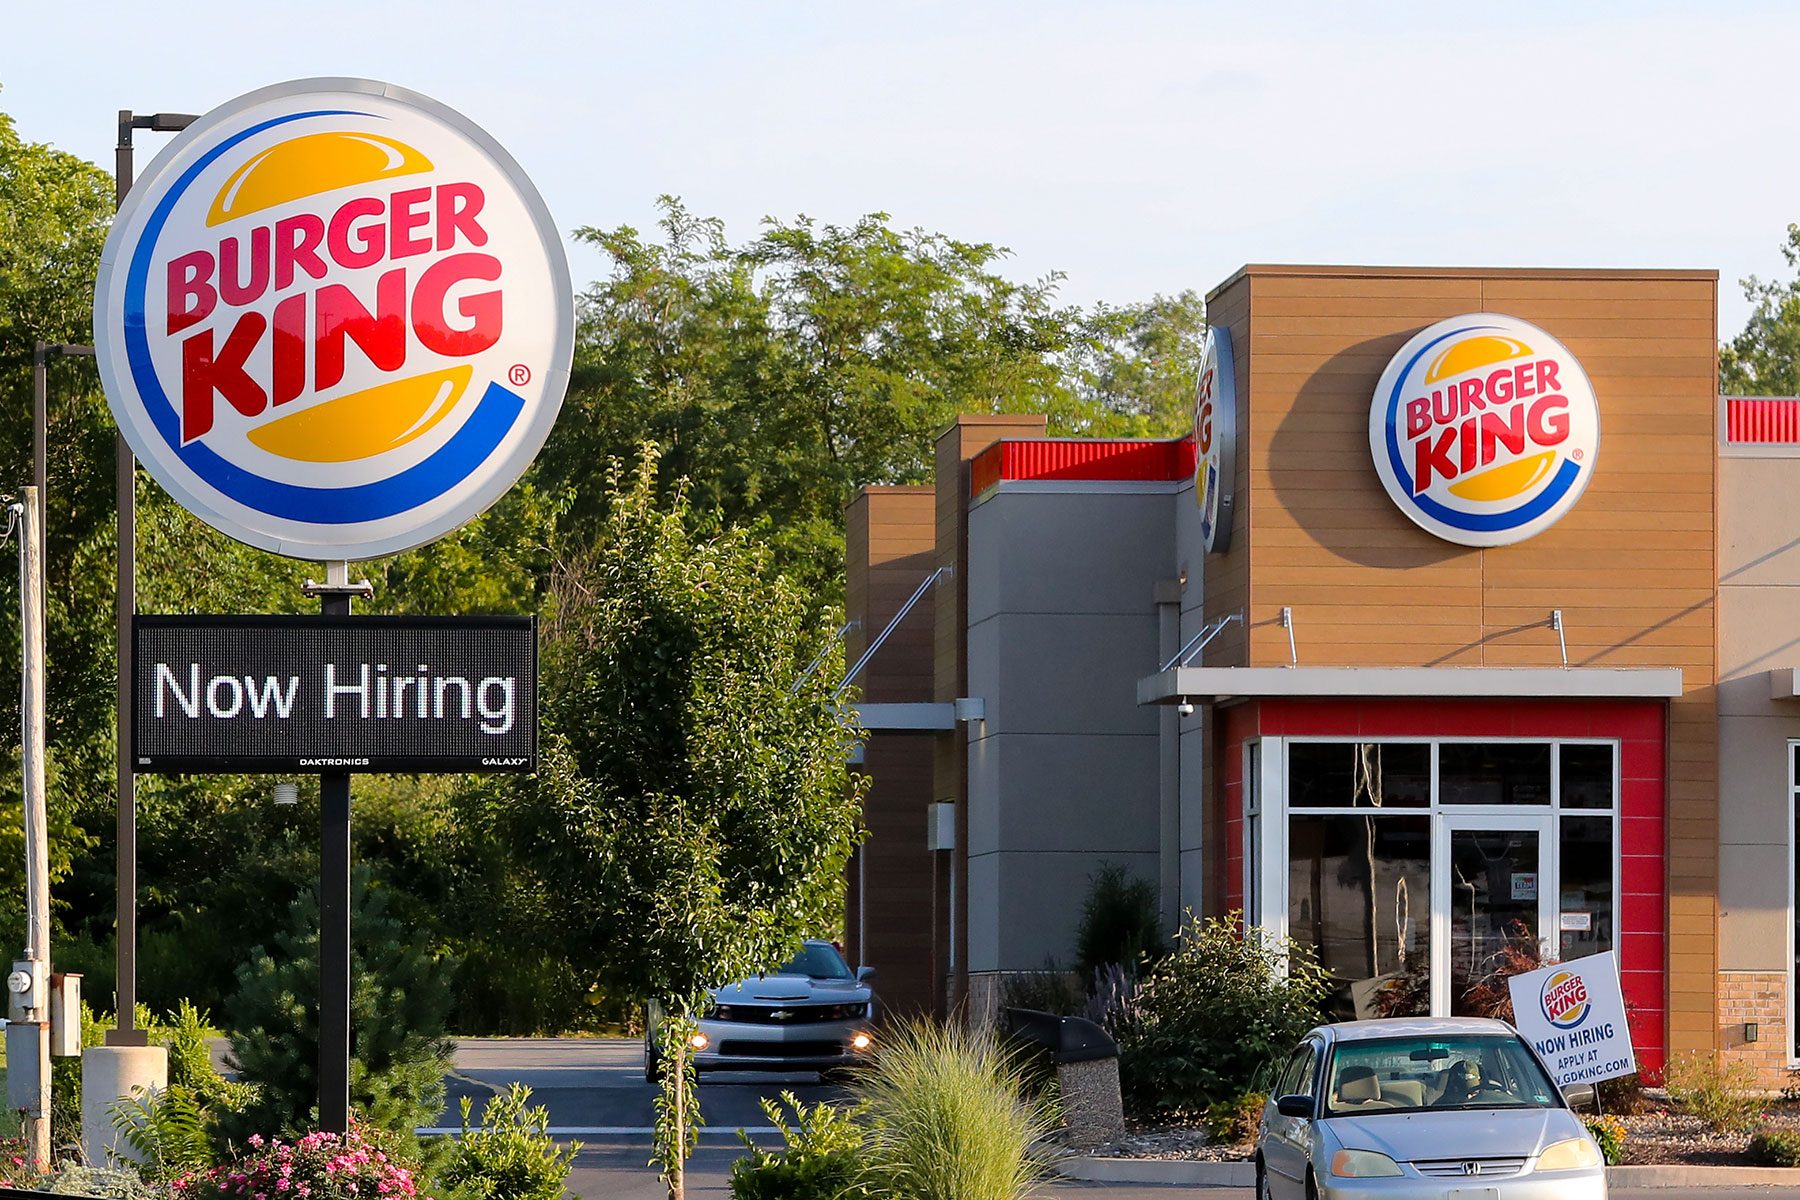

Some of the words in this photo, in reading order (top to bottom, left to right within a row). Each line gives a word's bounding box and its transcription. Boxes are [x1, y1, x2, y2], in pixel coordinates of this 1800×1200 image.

[167, 181, 488, 336] BURGER
[182, 252, 503, 443] KING
[1406, 359, 1562, 441] BURGER
[1415, 394, 1570, 494] KING
[153, 663, 299, 719] Now
[325, 663, 516, 735] Hiring
[299, 758, 370, 766] DAKTRONICS
[481, 757, 528, 766] GALAXY
[1544, 975, 1583, 1007] BURGER
[1548, 985, 1587, 1021] KING
[1536, 1035, 1566, 1056] NOW
[1569, 1022, 1614, 1049] HIRING
[1558, 1052, 1585, 1070] APPLY
[1587, 1049, 1598, 1063] AT
